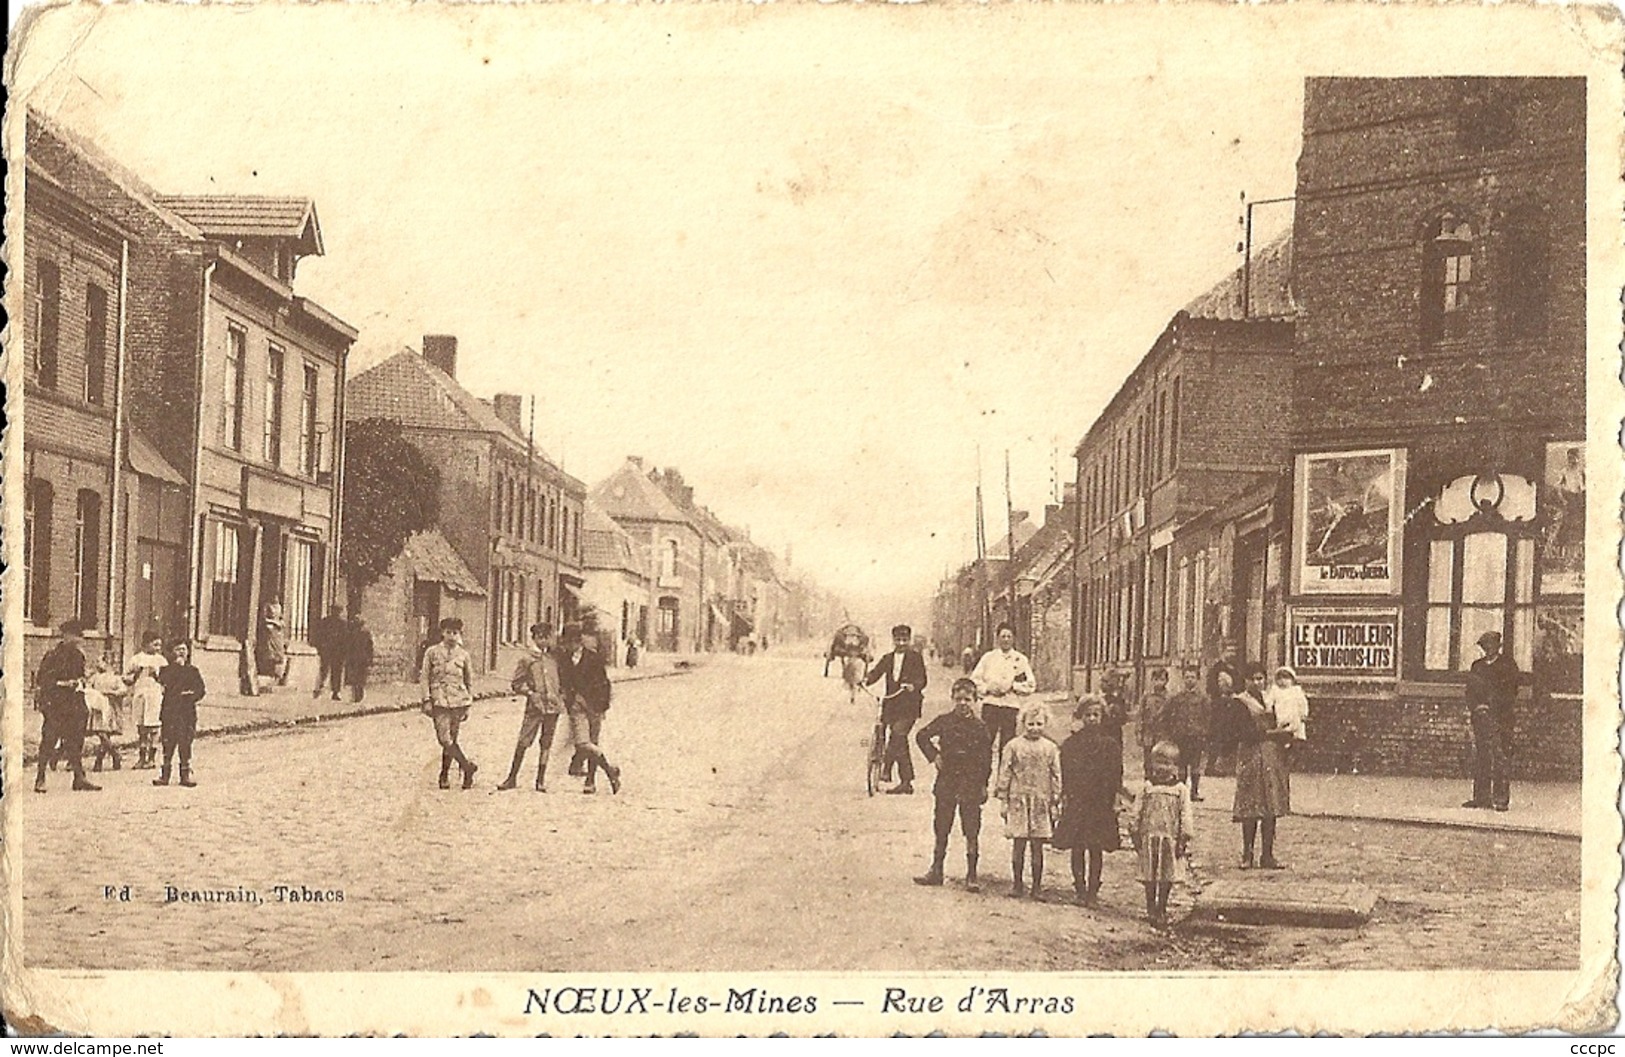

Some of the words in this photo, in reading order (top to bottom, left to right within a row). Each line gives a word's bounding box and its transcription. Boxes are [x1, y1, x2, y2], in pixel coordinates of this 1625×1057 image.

[1296, 625, 1310, 646] LE
[1314, 625, 1393, 647] CONTROLEUR
[1298, 647, 1318, 666] DES
[1320, 647, 1390, 667] WAGONS-LITS
[164, 885, 264, 905] Beaurain,
[274, 886, 344, 902] Tabacs
[523, 987, 817, 1014] NŒUX-les-Mines
[881, 988, 943, 1014] Rue
[957, 986, 1074, 1014] d'Arras
